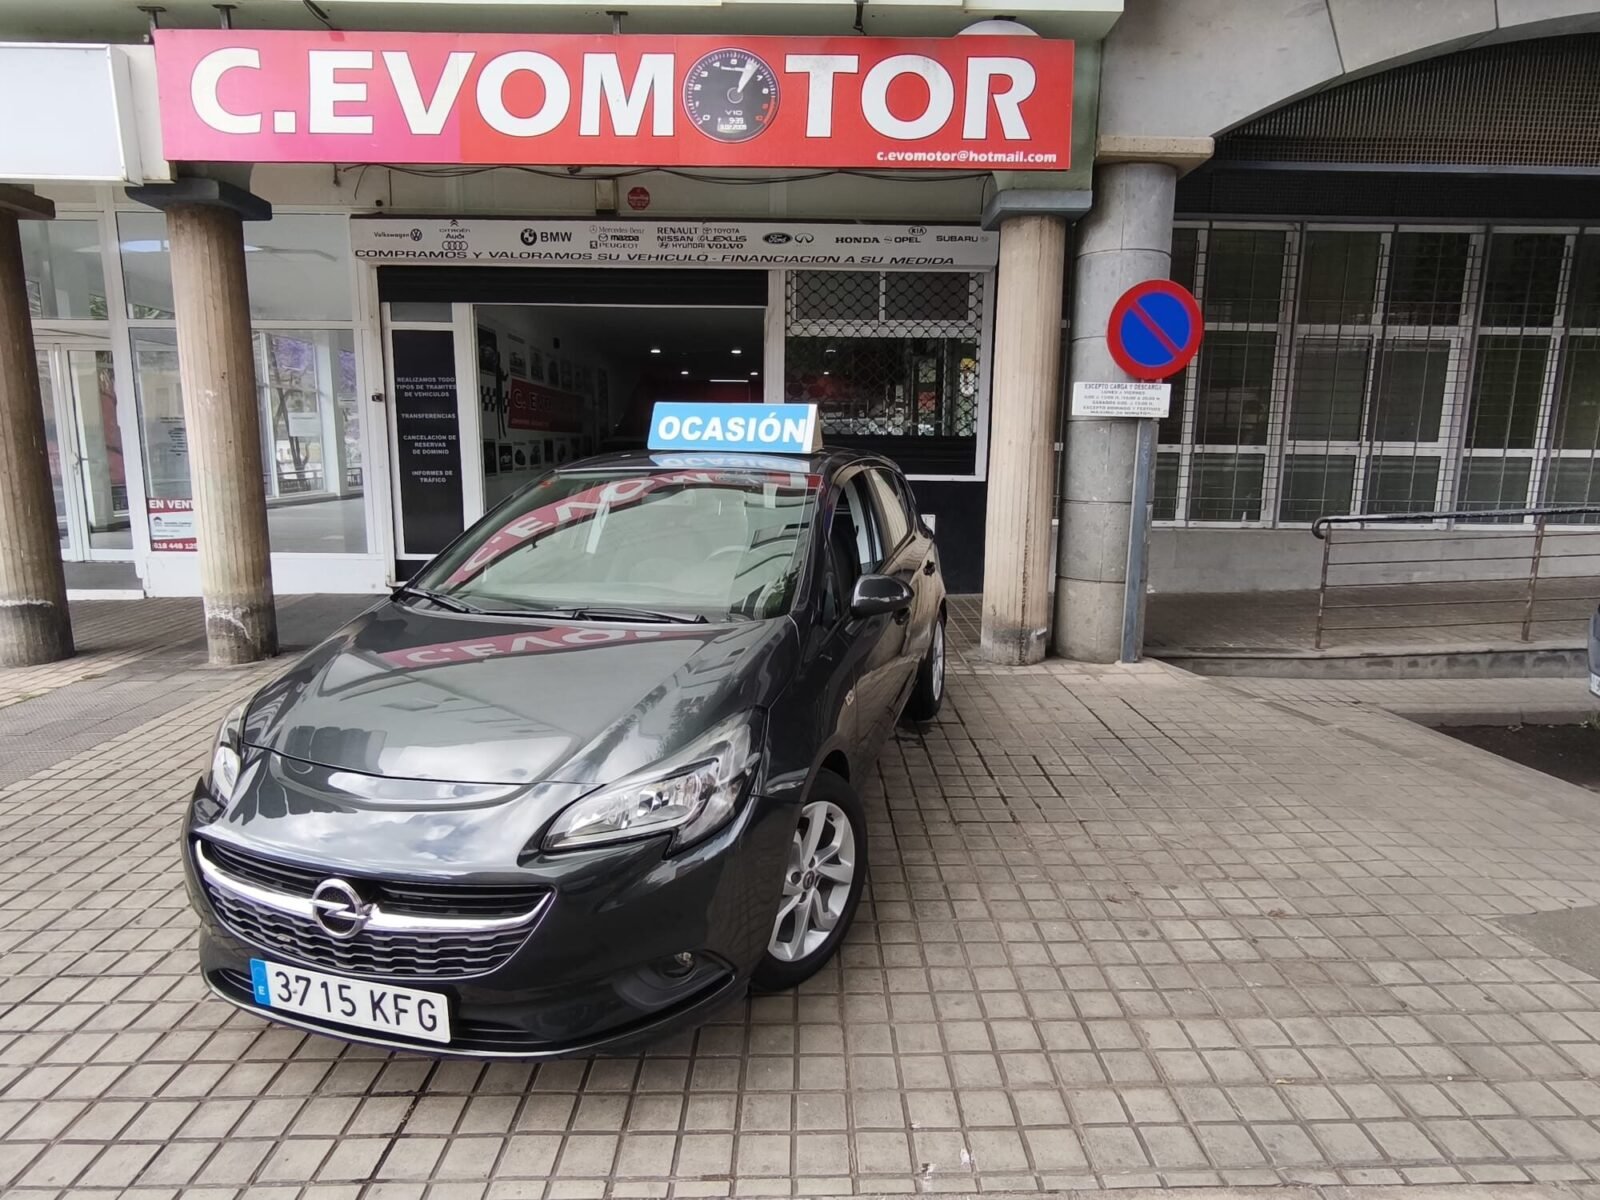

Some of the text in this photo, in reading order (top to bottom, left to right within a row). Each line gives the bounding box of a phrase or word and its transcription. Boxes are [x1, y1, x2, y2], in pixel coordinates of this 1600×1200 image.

[876, 150, 1057, 163] c.evomotor@hotmail.com
[373, 231, 410, 239] Volkswagen
[540, 231, 573, 242] BMW
[656, 227, 699, 235] RENAULT
[835, 236, 880, 244] HONDA
[894, 236, 921, 244] OPEL
[355, 249, 468, 259] COMPRAMOS
[471, 251, 484, 259] Y
[488, 251, 593, 261] VALORAMOS
[597, 252, 621, 261] SU
[721, 254, 840, 264] FINANCIACION
[844, 255, 855, 264] A
[860, 256, 884, 264] SU
[889, 257, 955, 265] MEDIDA
[658, 412, 808, 444] OCASIÓN
[149, 499, 164, 509] EN
[258, 985, 266, 996] E
[275, 971, 438, 1032] 3715 KFG
